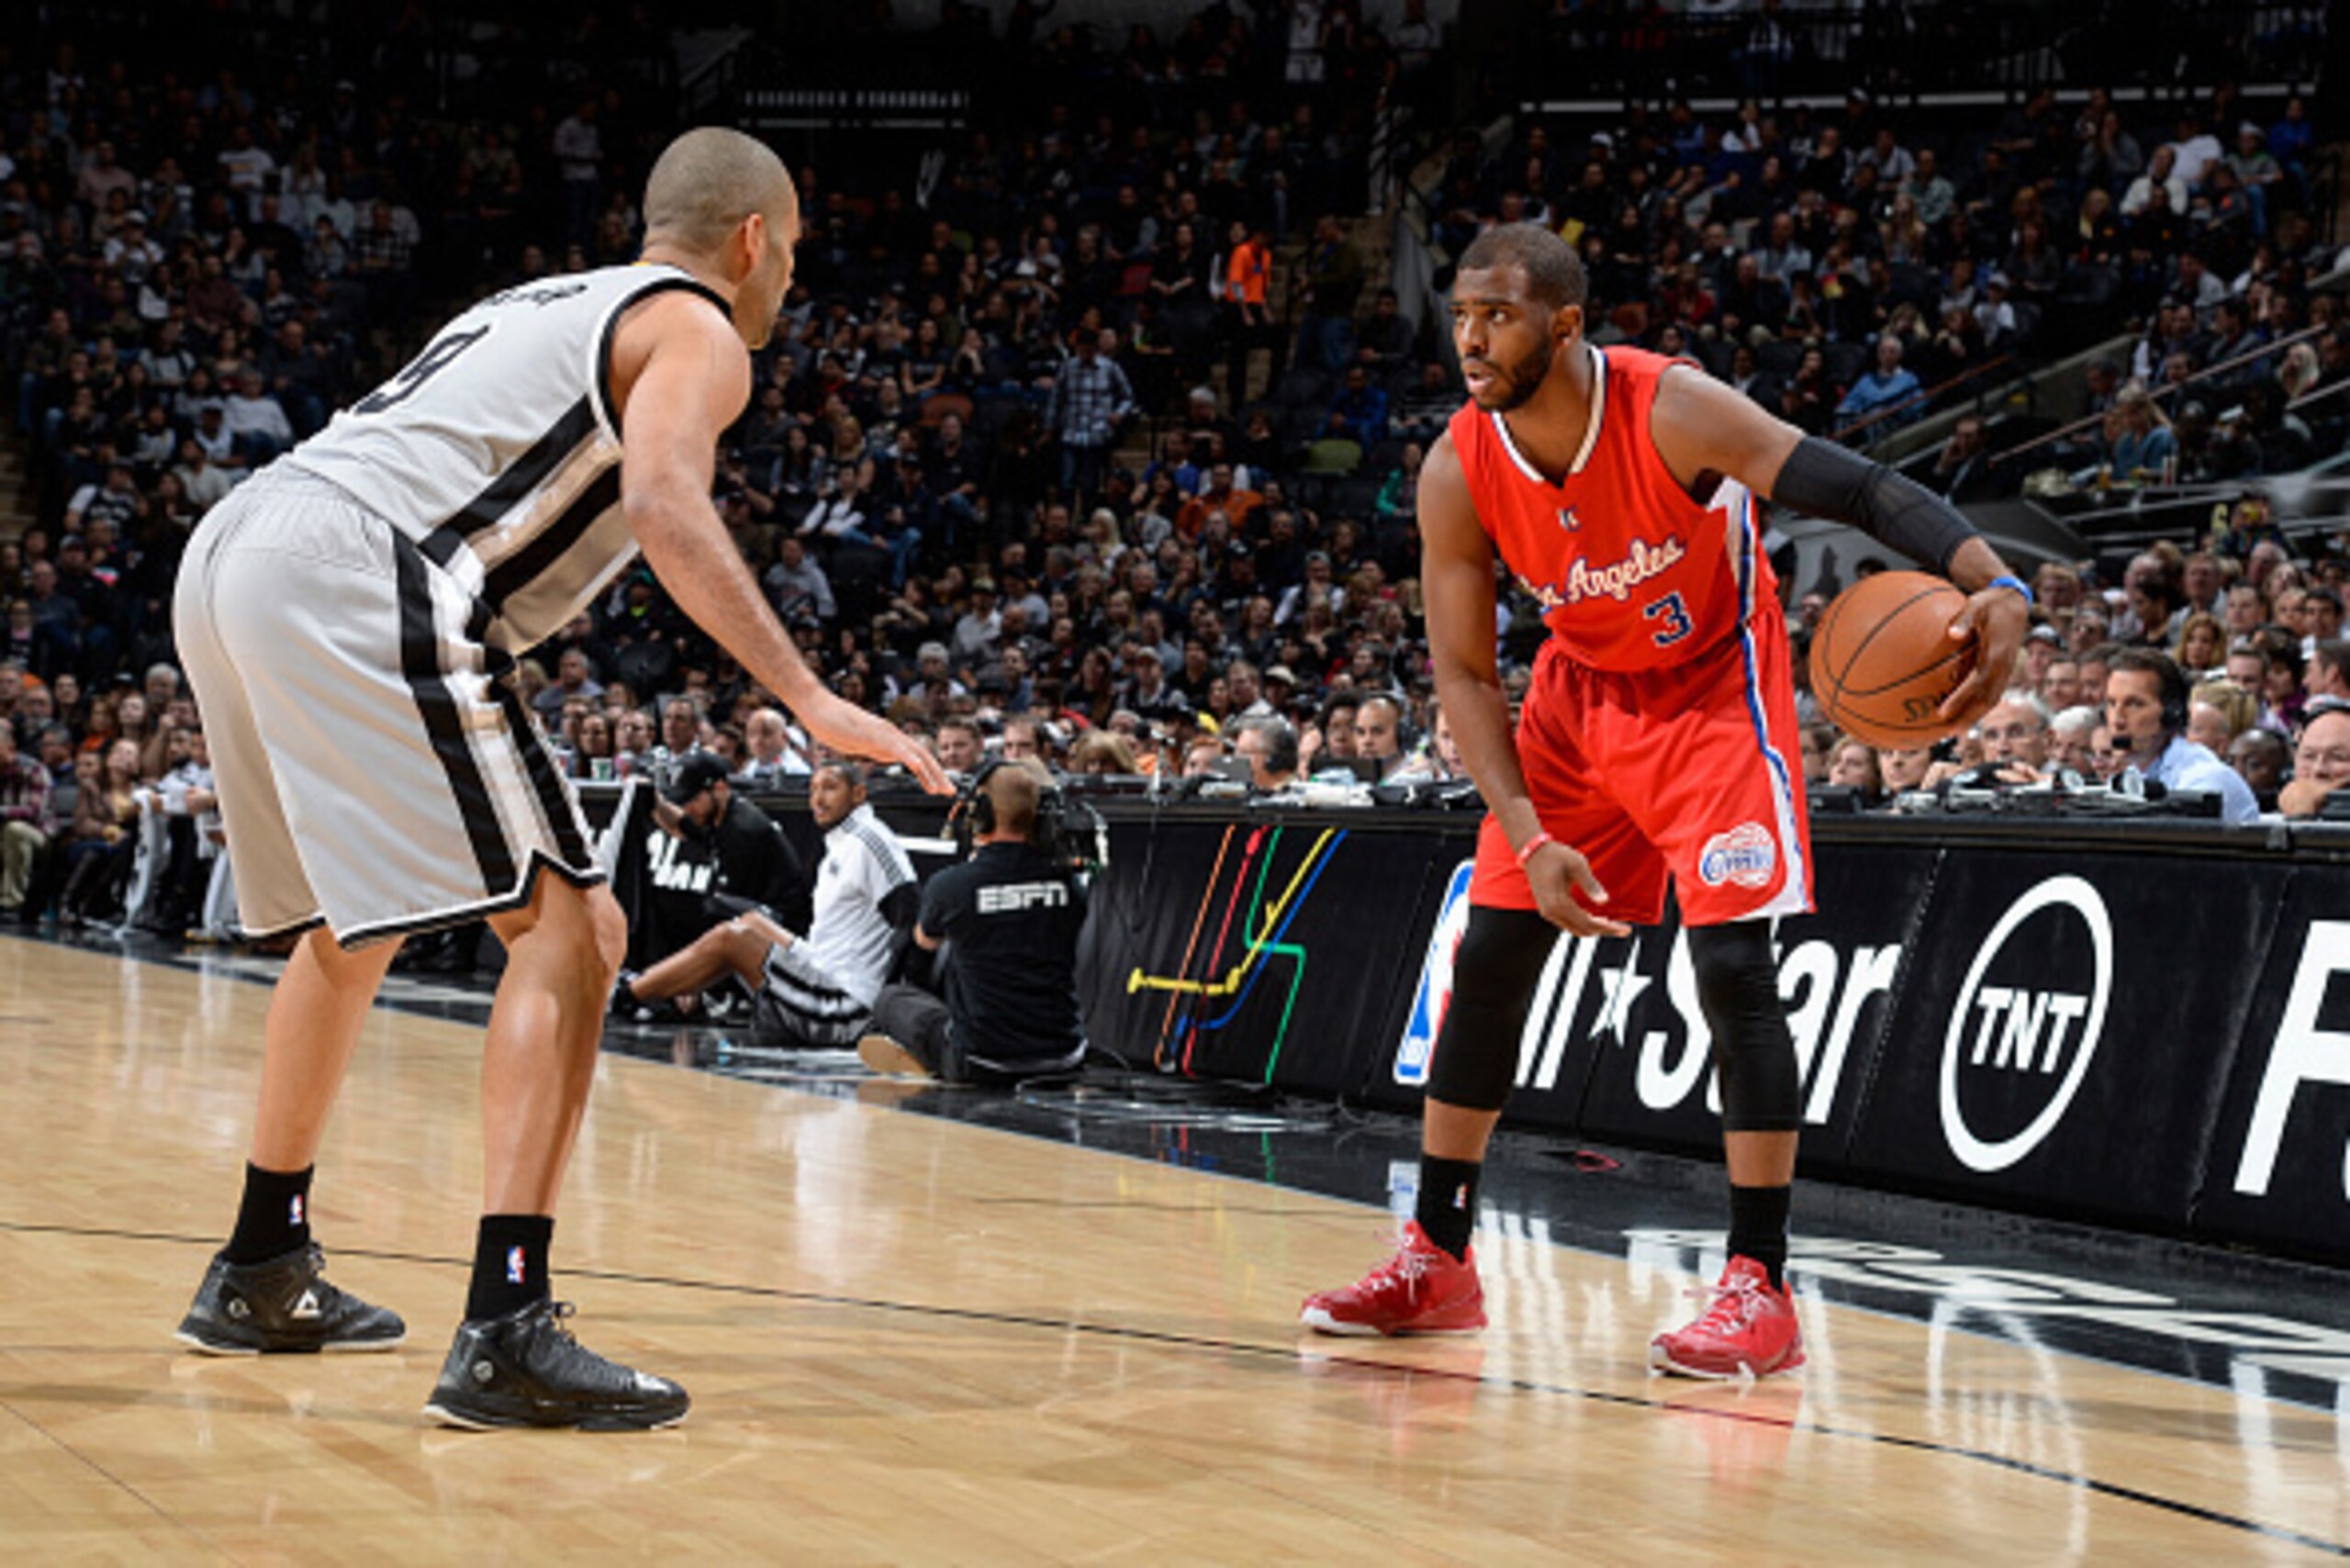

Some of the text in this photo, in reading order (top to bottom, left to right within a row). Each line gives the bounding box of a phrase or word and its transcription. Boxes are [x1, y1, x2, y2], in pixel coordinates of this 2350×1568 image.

[1567, 532, 1686, 603] Angeles
[1643, 591, 1694, 648] 3
[978, 881, 1068, 913] ESPN
[1636, 922, 1902, 1125] Sar
[1970, 986, 2088, 1073] TNT
